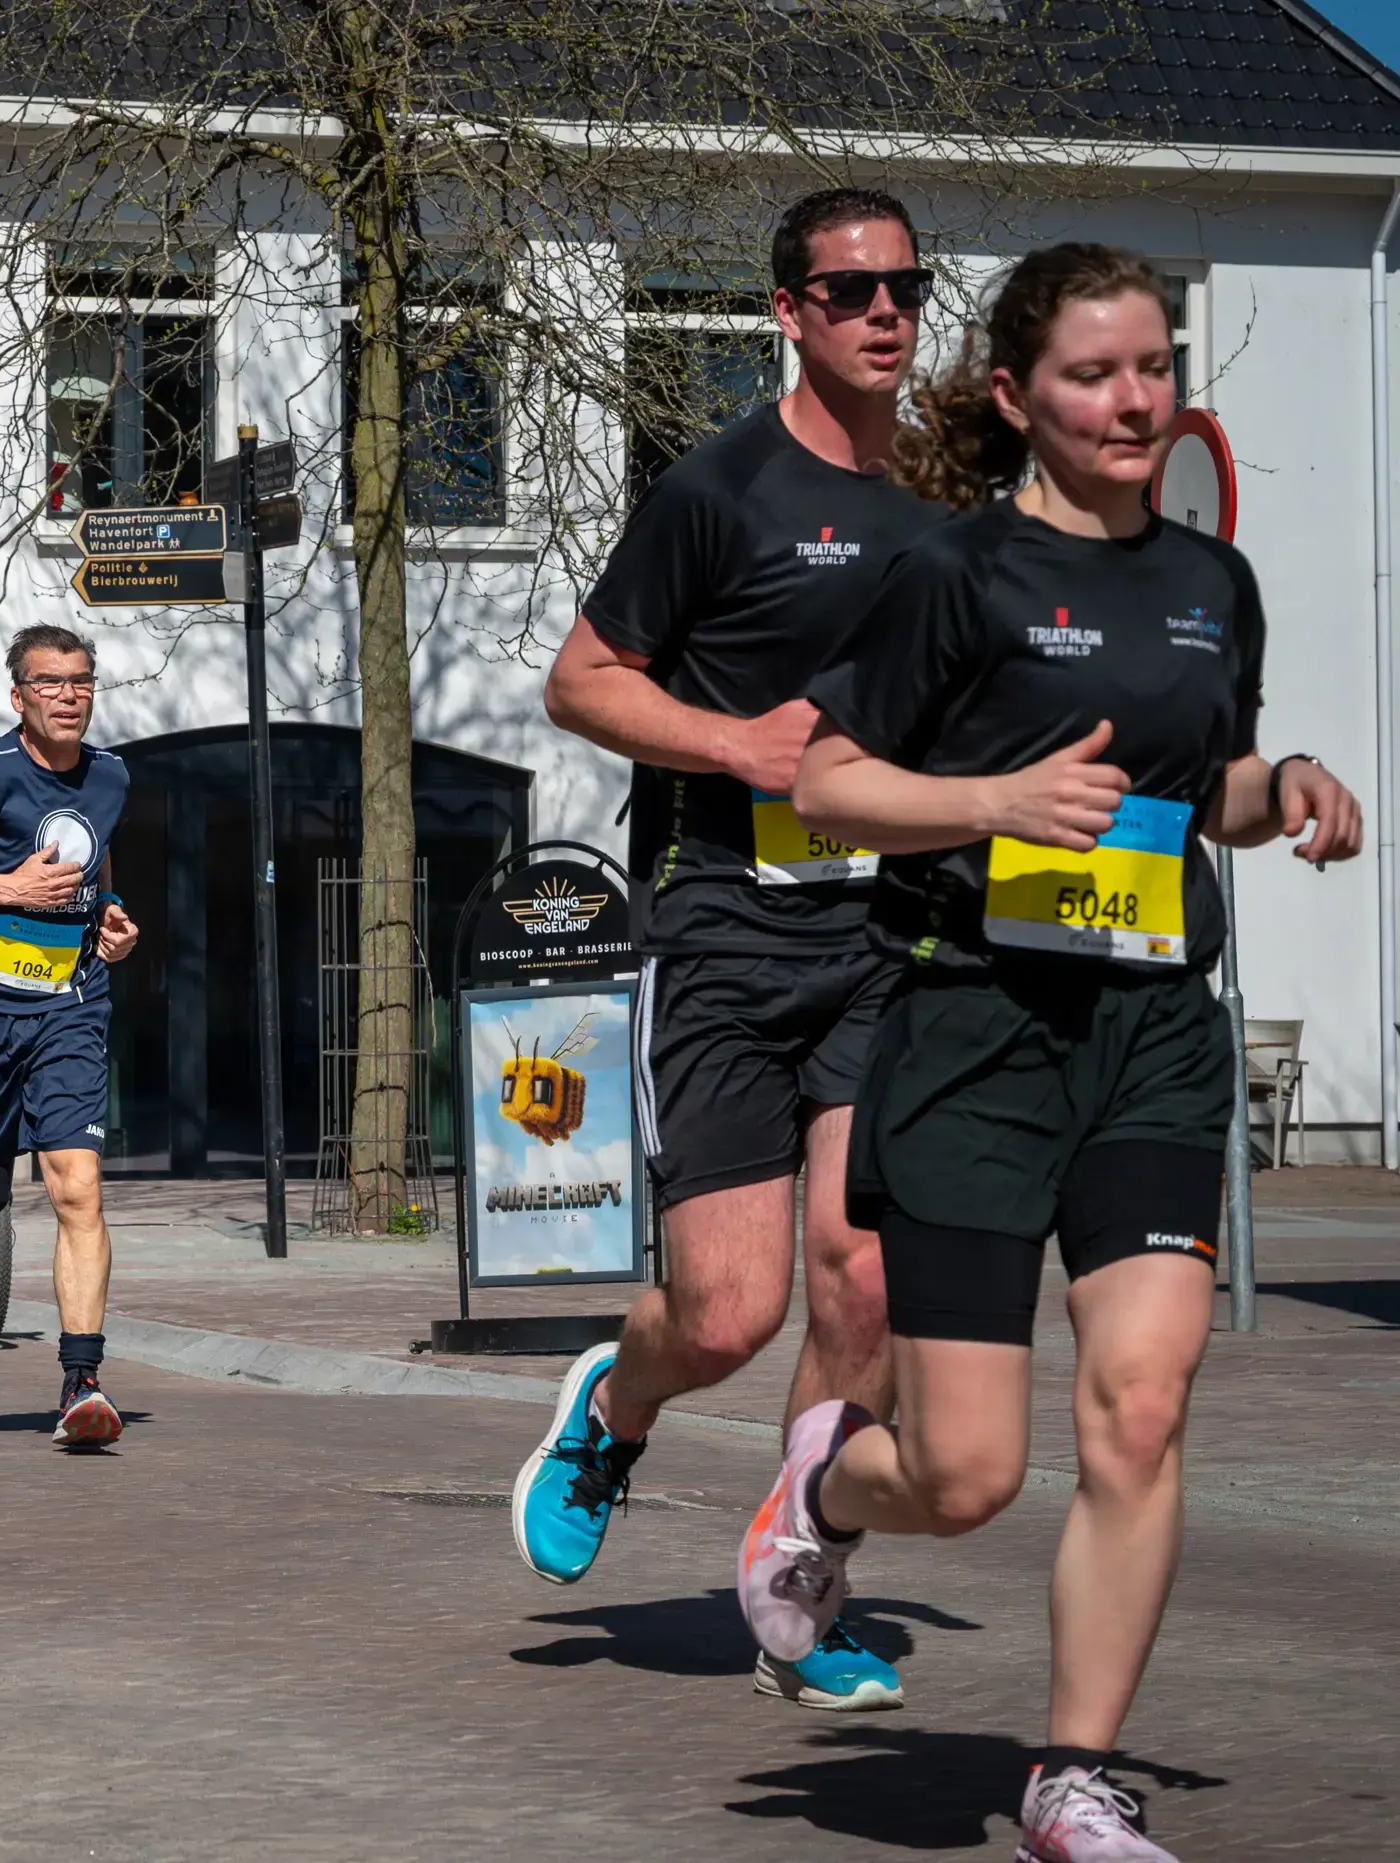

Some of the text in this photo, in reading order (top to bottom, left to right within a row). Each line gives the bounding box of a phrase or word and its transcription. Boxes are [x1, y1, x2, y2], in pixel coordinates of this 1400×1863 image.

[89, 511, 204, 527] Reynaertmonument
[90, 527, 154, 540] Havenfort
[90, 538, 165, 552] Wandelpark
[796, 542, 861, 557] TRIATHLON
[91, 563, 133, 573] Politie
[808, 556, 847, 565] WORLD
[91, 574, 178, 588] Bierbrouwerij
[1026, 626, 1104, 647] TRIATHLON
[1043, 645, 1091, 657] WORLD
[532, 896, 580, 911] KONING
[1054, 886, 1139, 926] 5048
[545, 909, 569, 921] VAN
[524, 919, 590, 935] ENGELAND
[480, 949, 534, 962] BIOSCOOP
[545, 946, 566, 957] BAR
[577, 942, 632, 955] BRASSERIE
[12, 959, 53, 980] 1094
[85, 1123, 105, 1139] JAKO
[486, 1179, 622, 1213] MINECRAFT
[530, 1213, 579, 1224] MOVIE
